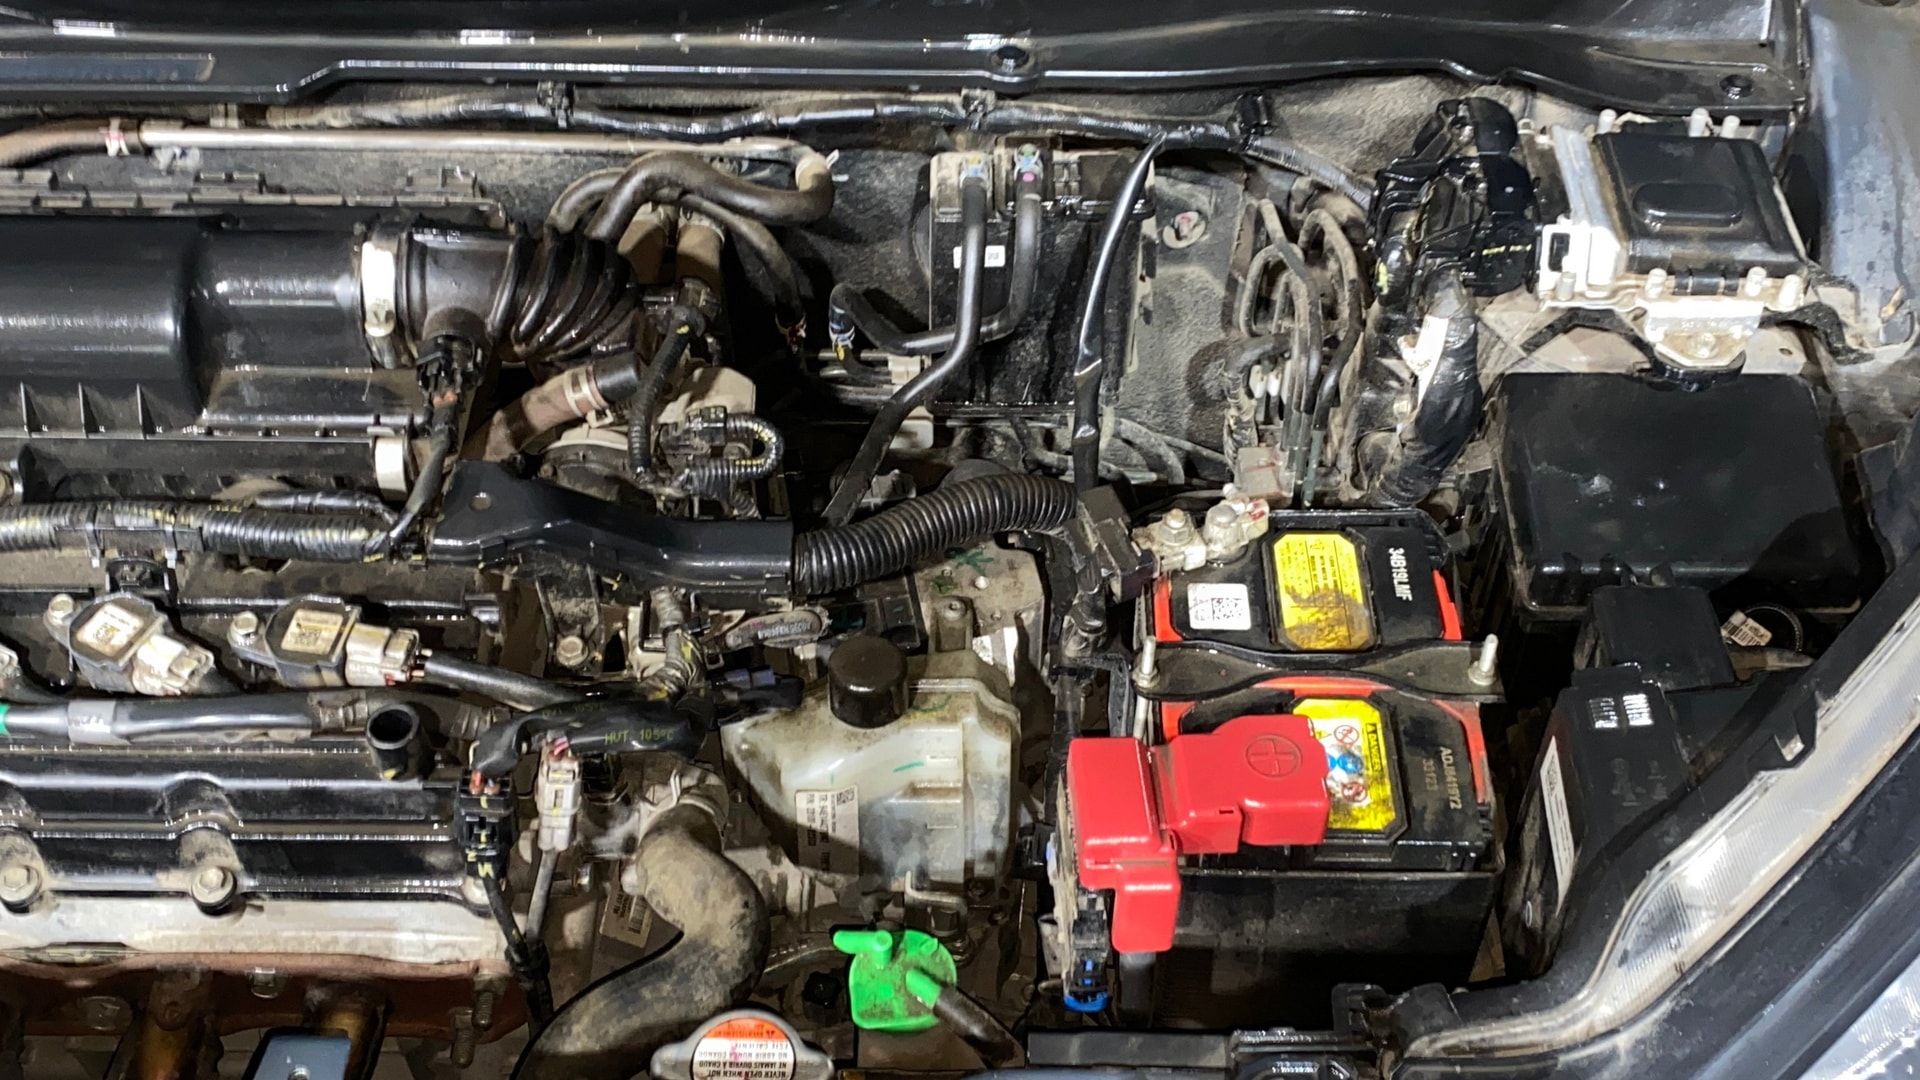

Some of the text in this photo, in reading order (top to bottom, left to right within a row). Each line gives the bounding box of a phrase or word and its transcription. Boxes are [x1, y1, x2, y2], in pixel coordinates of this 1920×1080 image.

[1388, 547, 1412, 601] 34B19LMF
[1368, 733, 1382, 772] DANGER
[699, 1061, 721, 1069] CHAUD
[745, 1071, 763, 1079] OPEN
[764, 1071, 787, 1079] NEVER
